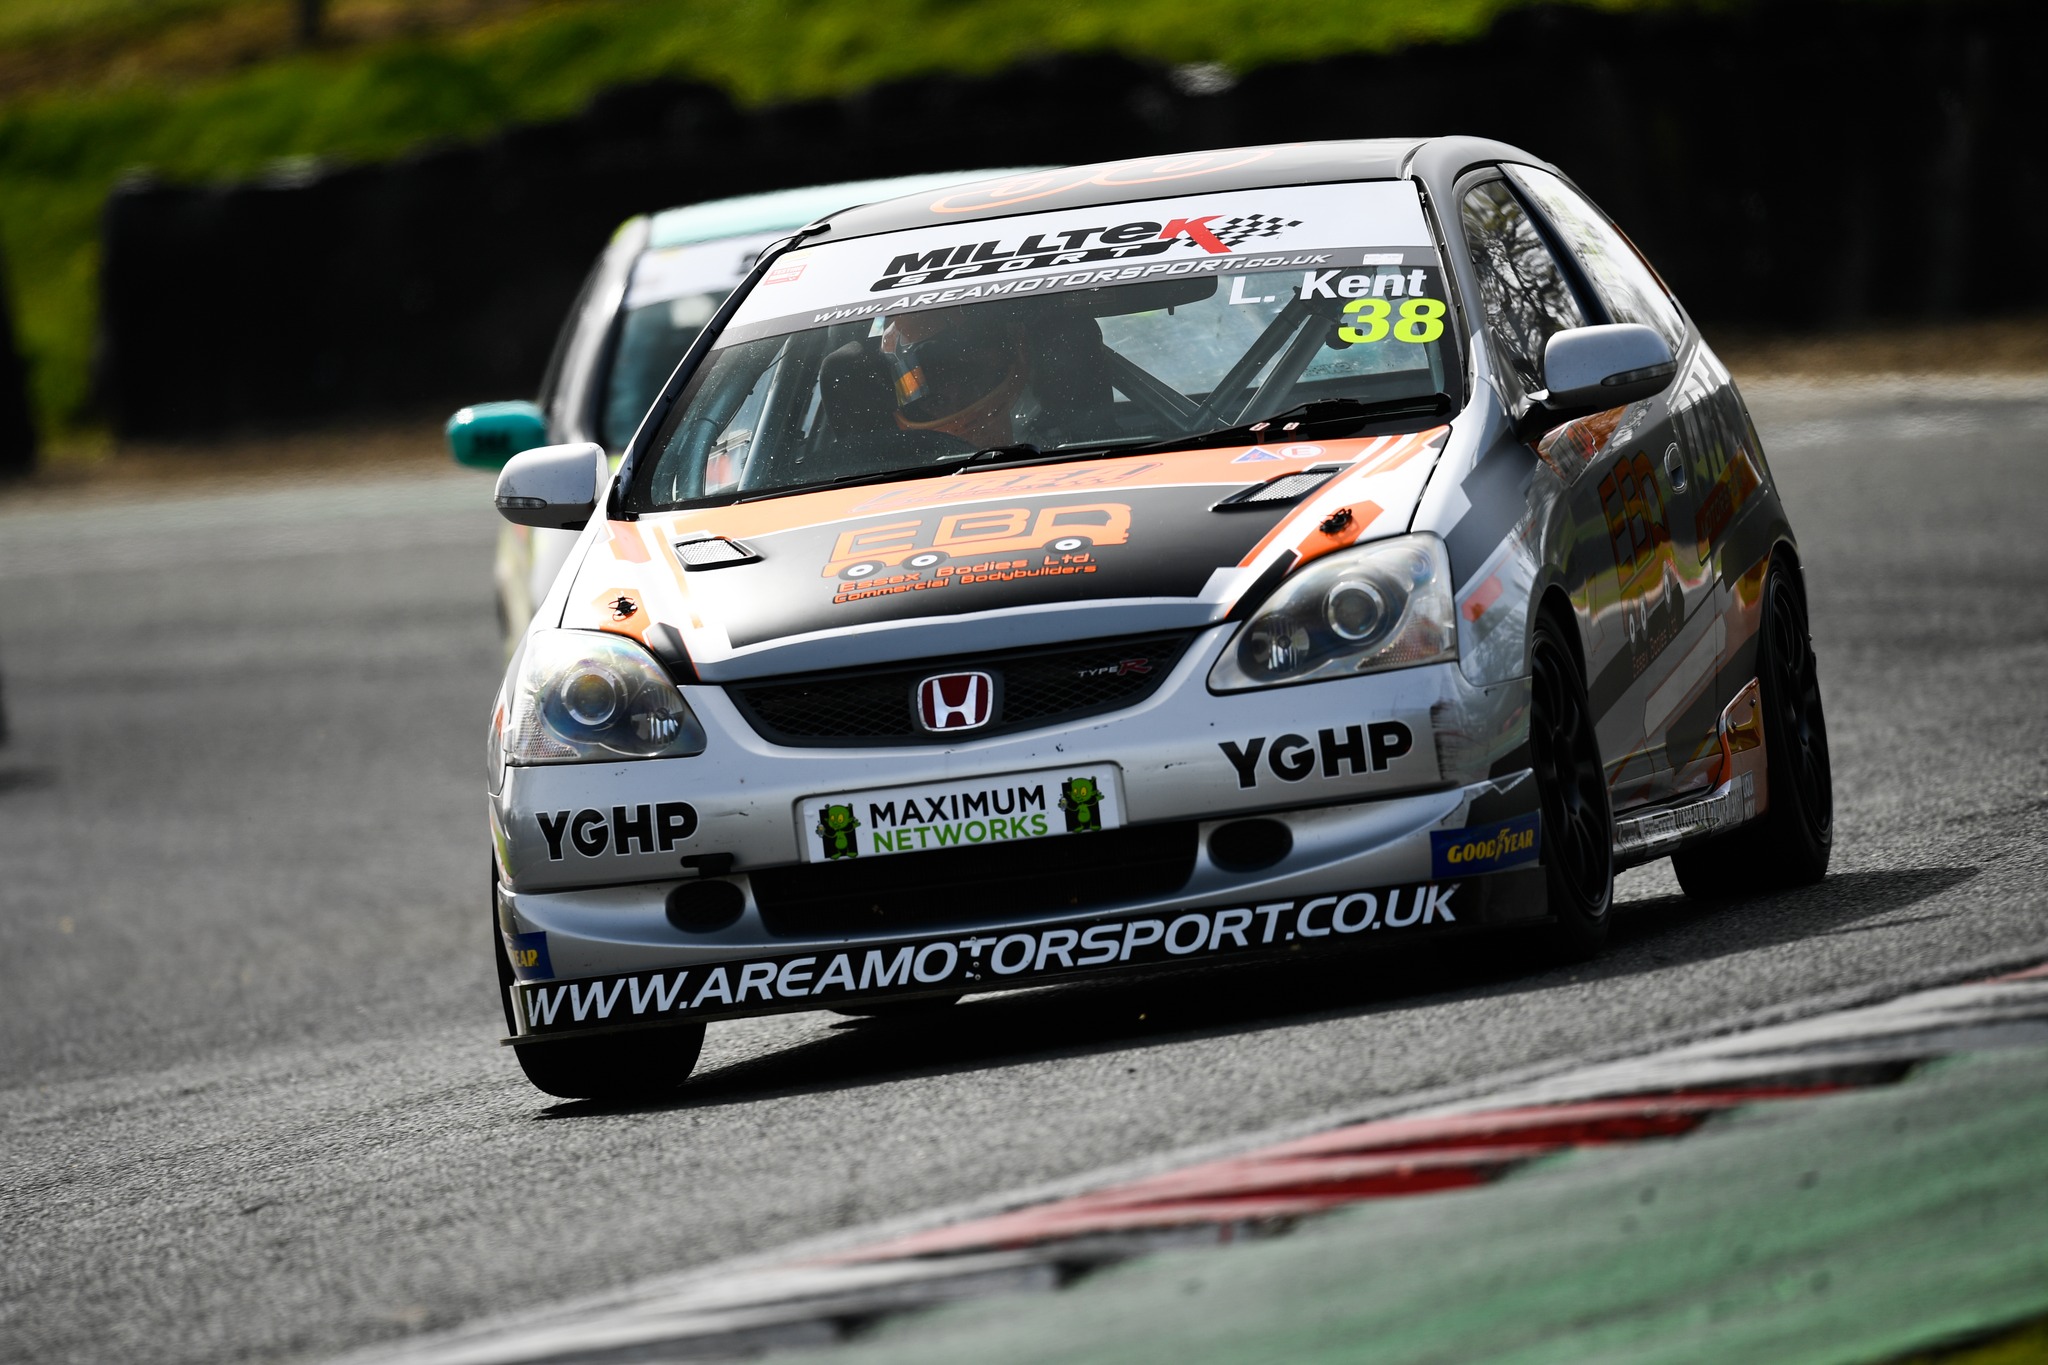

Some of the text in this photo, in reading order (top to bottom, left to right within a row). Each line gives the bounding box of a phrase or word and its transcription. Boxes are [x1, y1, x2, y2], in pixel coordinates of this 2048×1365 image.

[891, 245, 1142, 288] SPORT
[1229, 268, 1426, 305] L. Kent
[1337, 299, 1446, 344] 38
[832, 564, 1098, 605] Commercial Bodybuilders
[836, 552, 1096, 594] Essex Bodies Ltd.
[1078, 658, 1153, 678] TYPE R
[1218, 719, 1414, 789] YGHP
[869, 784, 1046, 829] MAXIMUM
[535, 800, 699, 861] YGHP
[873, 813, 1049, 855] NETWORKS
[1447, 827, 1534, 864] GOODYEAR
[525, 881, 1461, 1028] WWW.AREAMOTORSPORT.CO.UK
